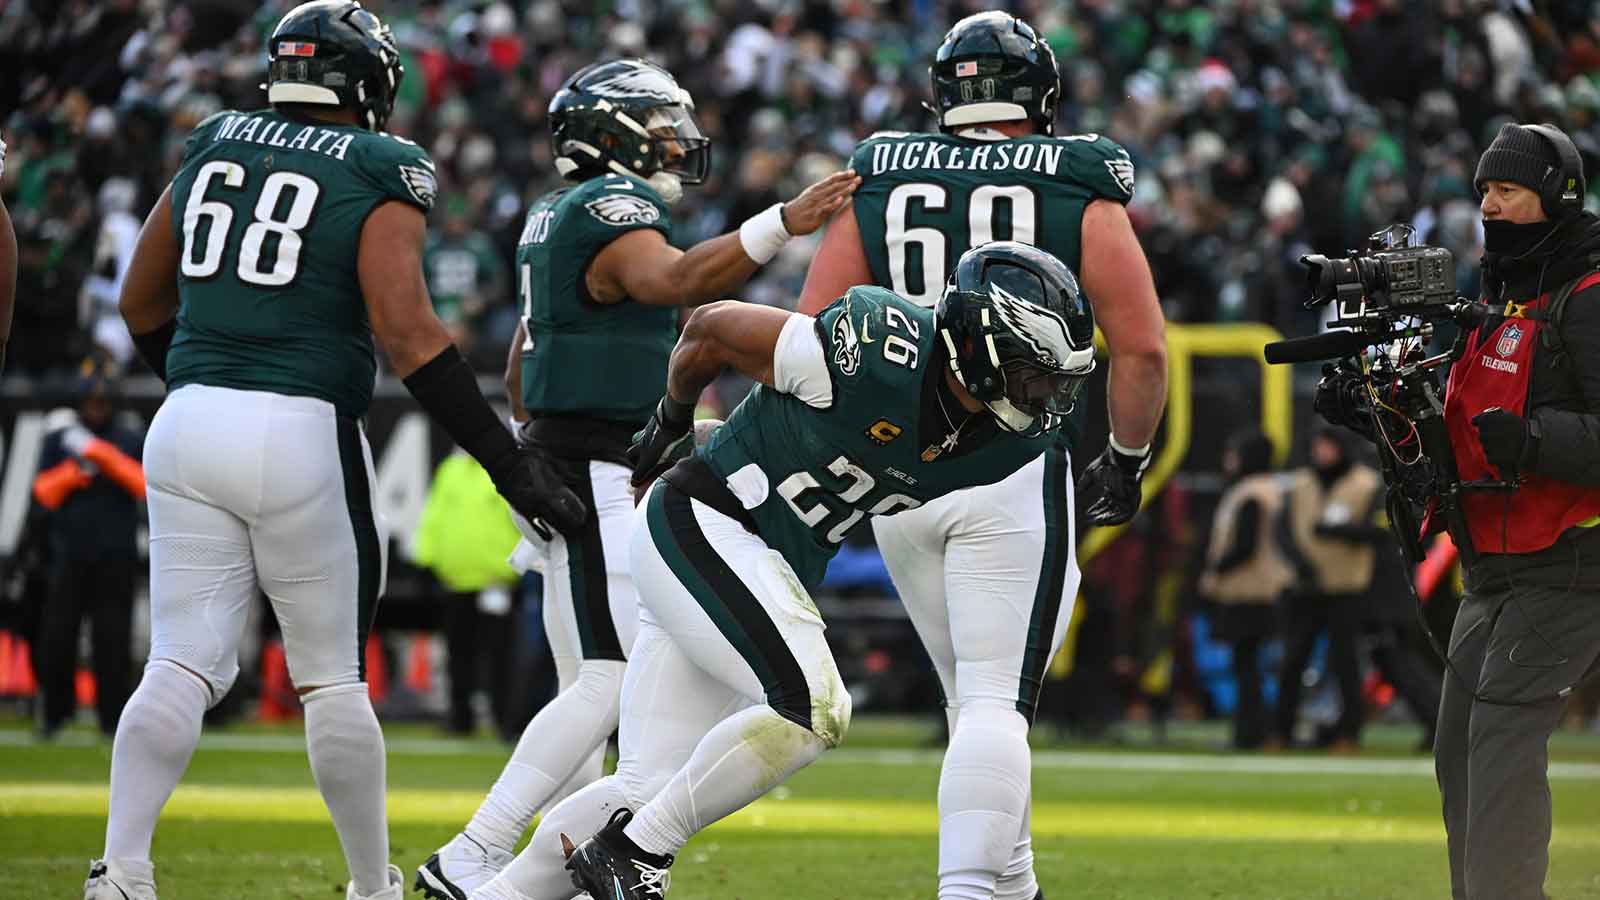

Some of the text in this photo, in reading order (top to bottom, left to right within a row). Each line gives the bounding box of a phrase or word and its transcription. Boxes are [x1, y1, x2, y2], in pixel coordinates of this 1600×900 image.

[214, 115, 354, 160] MAILATA
[871, 142, 1064, 176] DICKERSON
[181, 160, 320, 286] 68
[1481, 355, 1519, 375] TELEVISION
[886, 466, 917, 486] EAGLES
